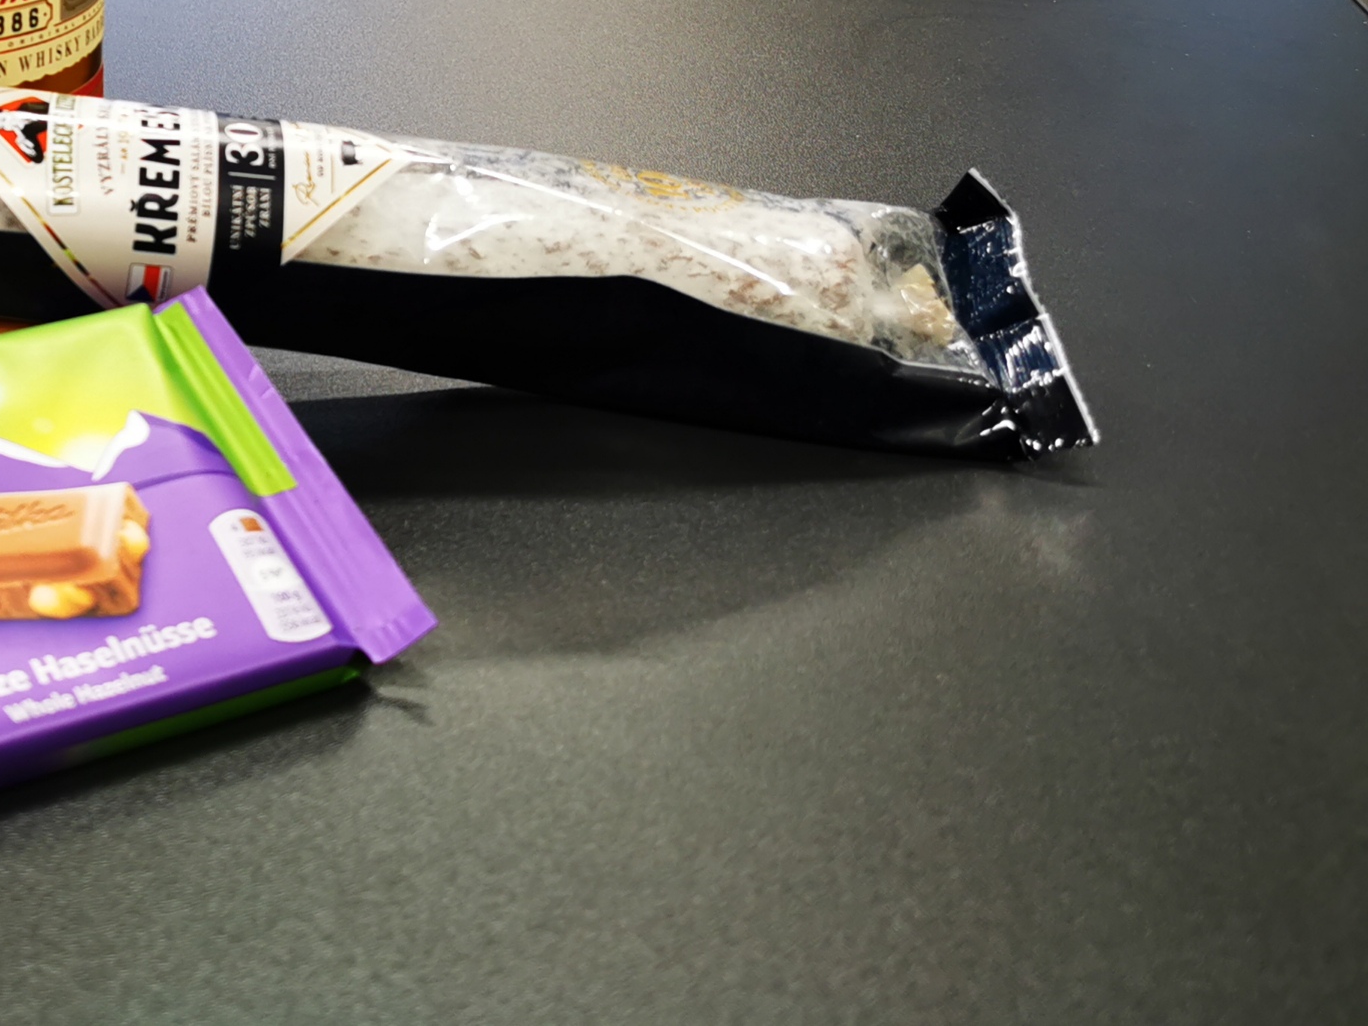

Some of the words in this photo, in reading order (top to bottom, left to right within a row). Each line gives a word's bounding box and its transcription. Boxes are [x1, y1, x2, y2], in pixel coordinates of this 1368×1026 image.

[6, 20, 76, 48] ORIGINAL
[17, 35, 82, 73] WHISKY
[224, 122, 265, 167] 30
[28, 616, 218, 686] Haselnüsse
[2, 691, 77, 724] Whole
